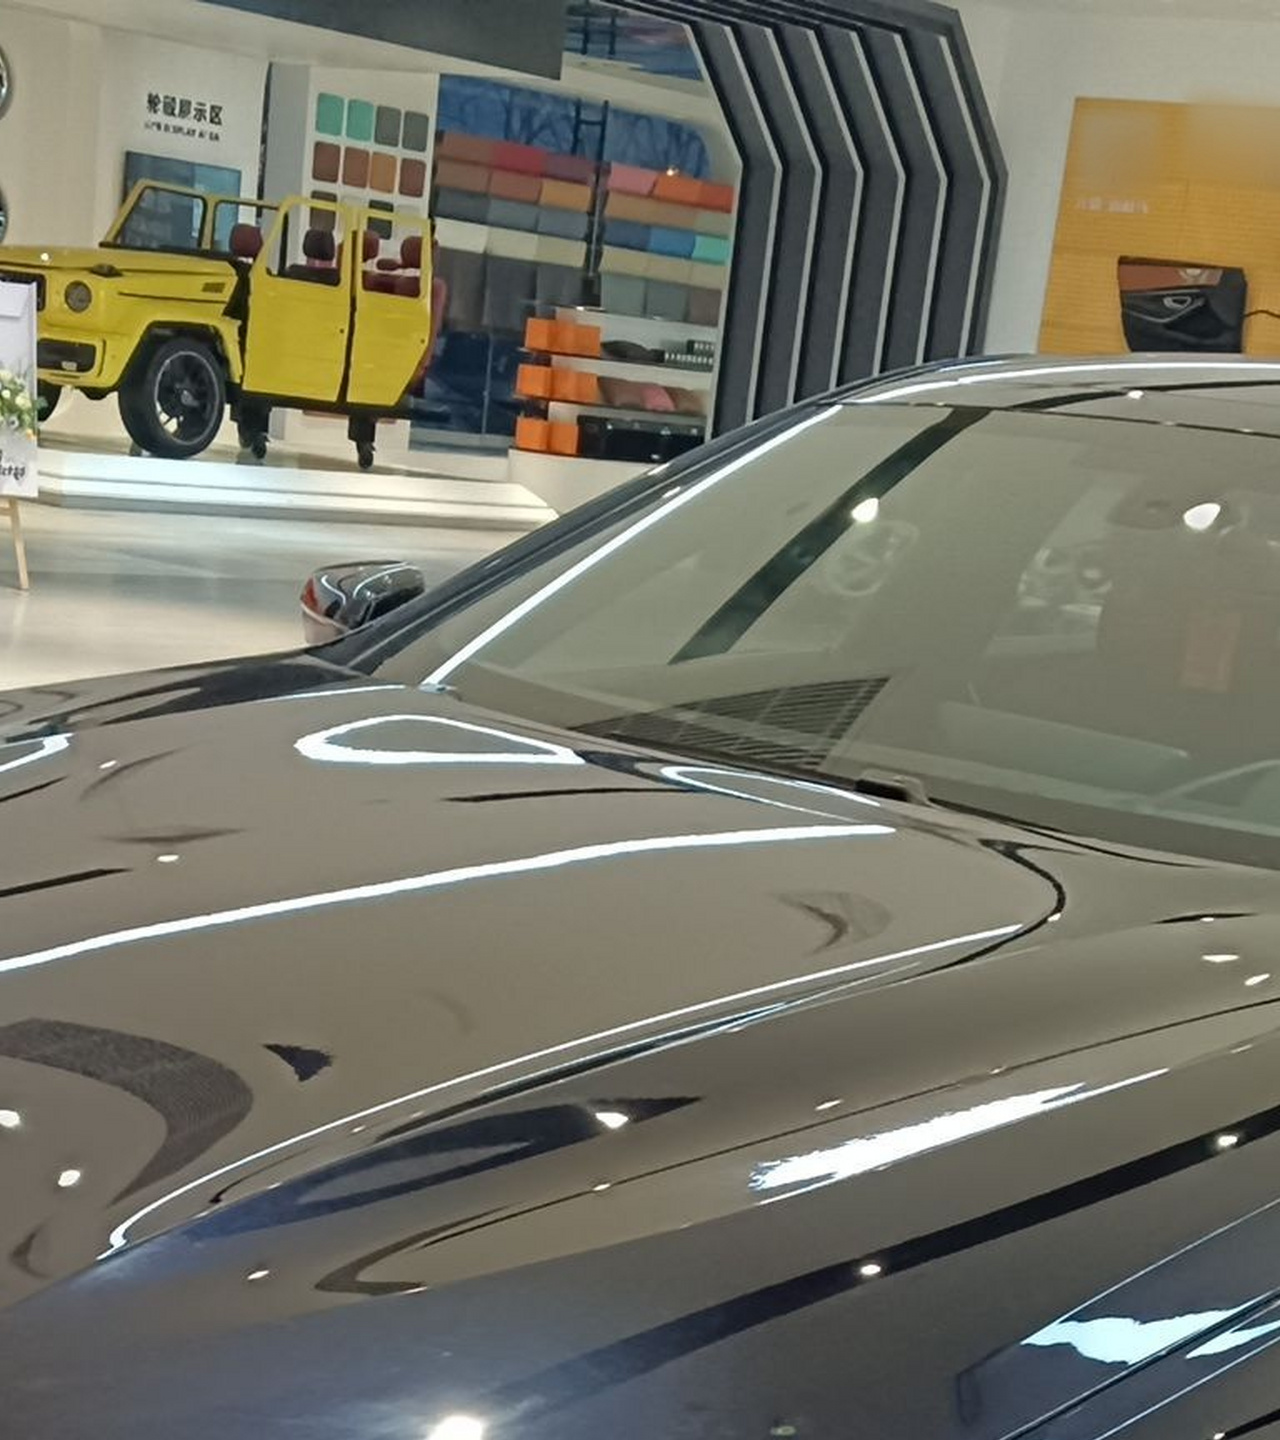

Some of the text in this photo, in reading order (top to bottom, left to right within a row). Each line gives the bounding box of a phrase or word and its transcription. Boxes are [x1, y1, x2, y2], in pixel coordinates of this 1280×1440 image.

[146, 93, 223, 126] 轮毂展示区
